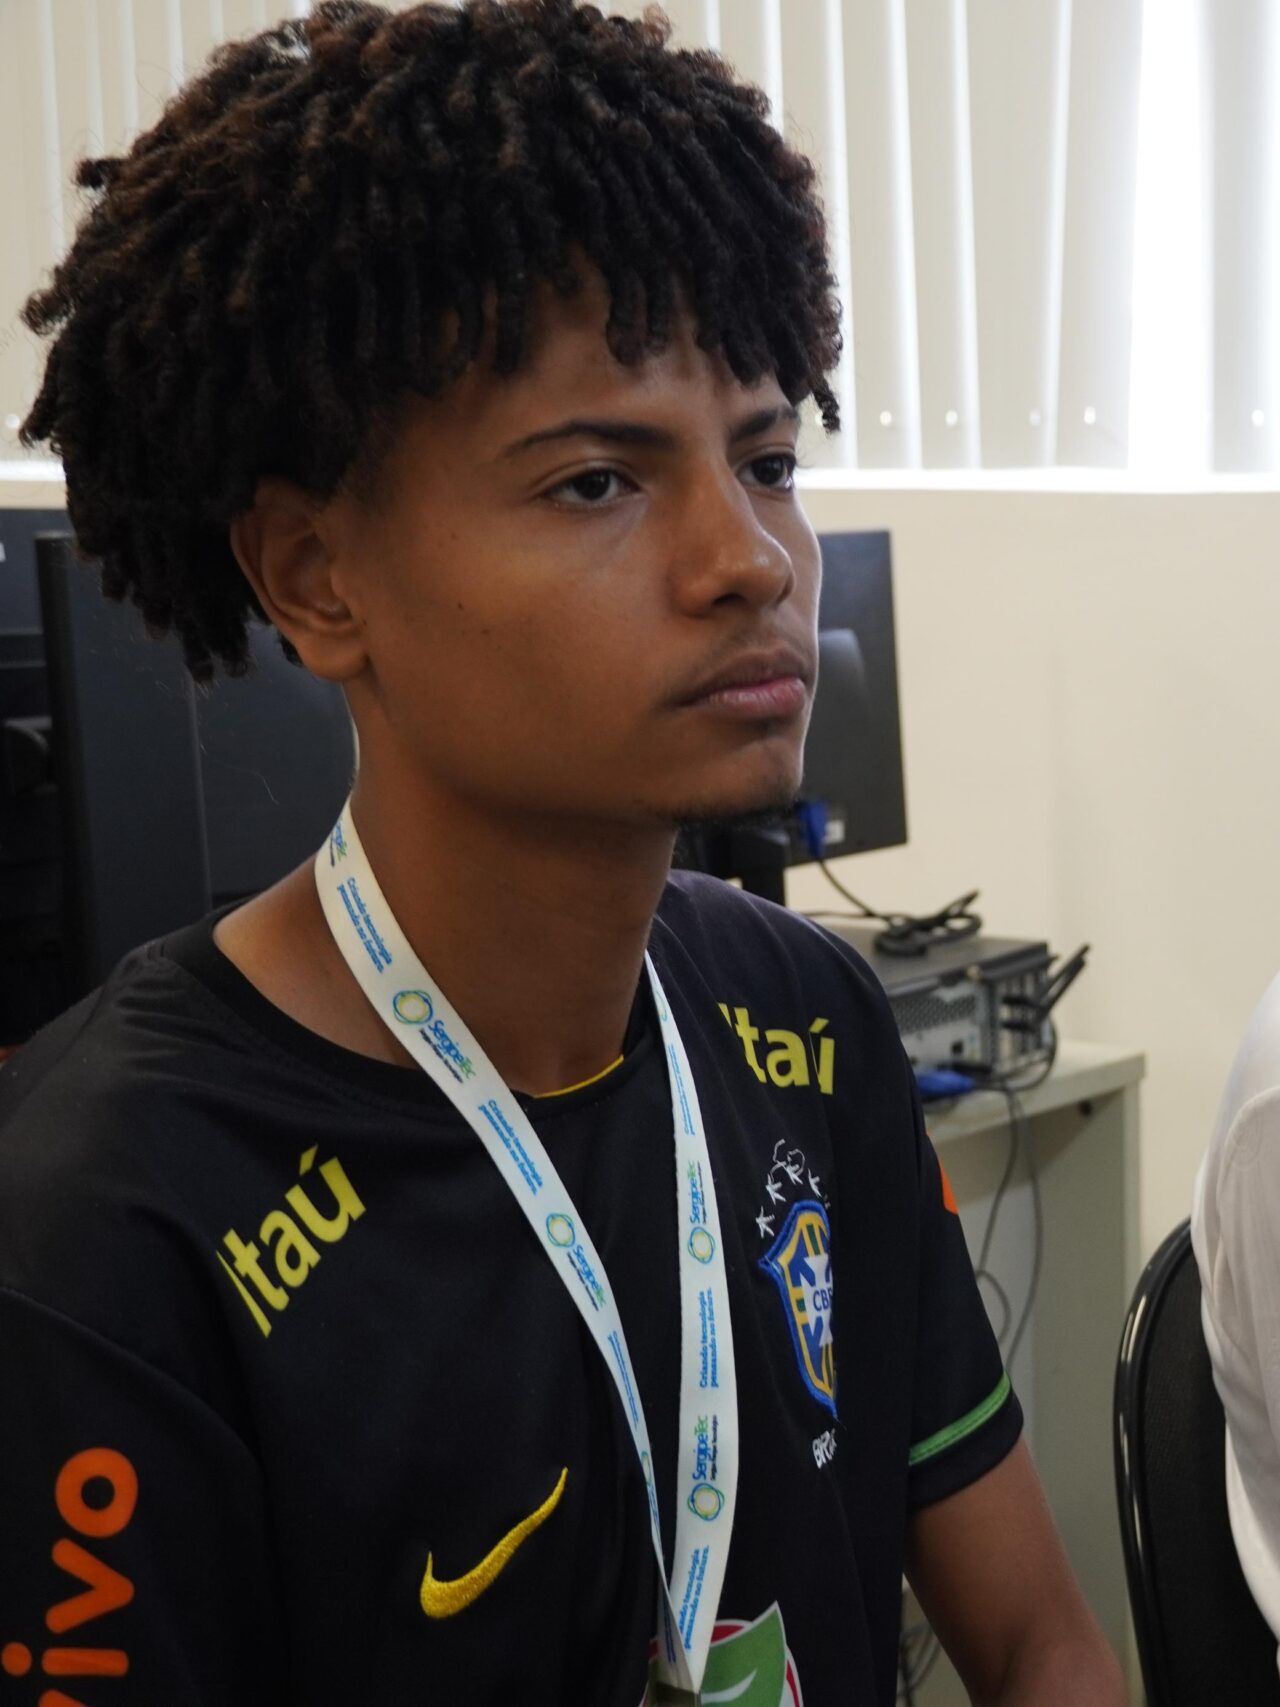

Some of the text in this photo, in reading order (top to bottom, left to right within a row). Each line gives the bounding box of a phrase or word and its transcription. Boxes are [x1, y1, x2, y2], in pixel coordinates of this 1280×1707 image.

[429, 1019, 476, 1080] SergipeTec
[478, 1104, 512, 1150] pensando
[488, 1100, 543, 1188] Criando tecnologia
[687, 1161, 702, 1224] SergipeTec
[574, 1245, 606, 1308] SergipeTec
[699, 1291, 708, 1388] Criando tecnologia
[710, 1337, 720, 1388] pensando
[692, 1415, 710, 1481] SergipeTec
[1, 1448, 138, 1707] ivo
